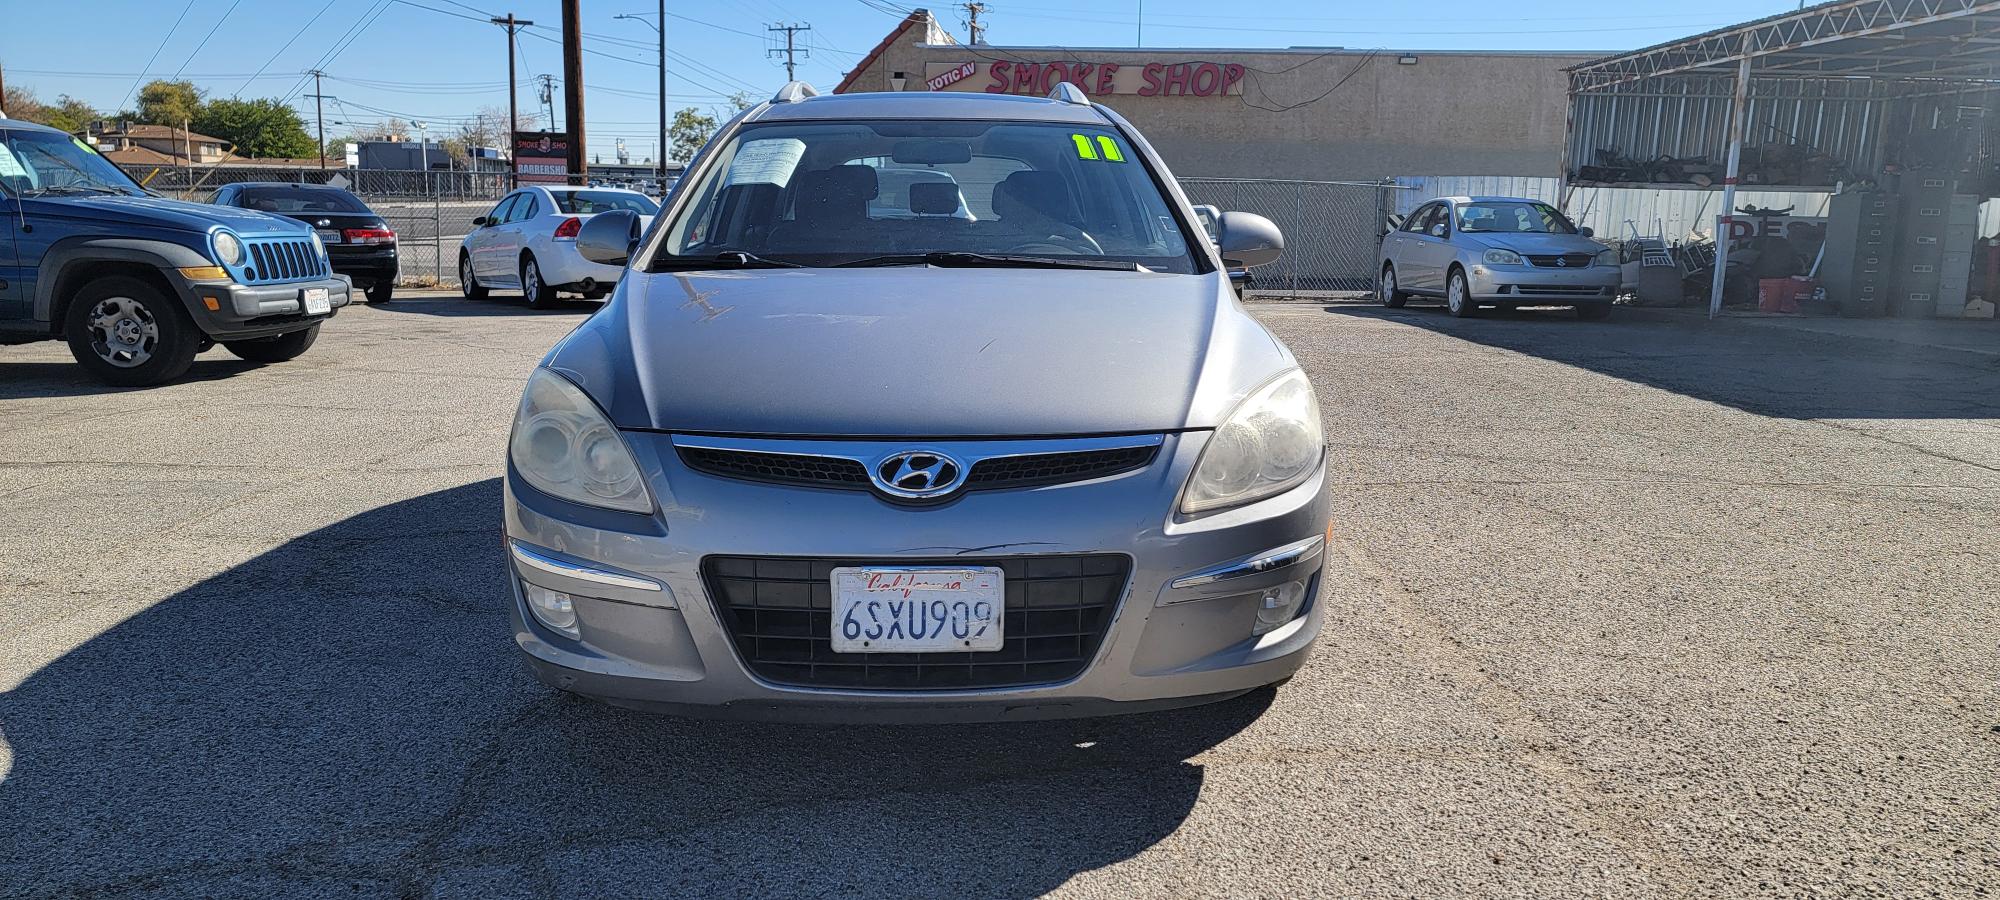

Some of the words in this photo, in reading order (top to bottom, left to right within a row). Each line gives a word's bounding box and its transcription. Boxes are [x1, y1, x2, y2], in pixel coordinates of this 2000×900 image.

[985, 60, 1120, 96] SMOKE
[1137, 62, 1246, 97] SHOP
[518, 140, 539, 150] SMOKE
[551, 141, 567, 149] SHO
[1072, 134, 1124, 162] 11
[518, 164, 566, 176] BARBERSHO
[842, 600, 992, 640] 6SXU909
